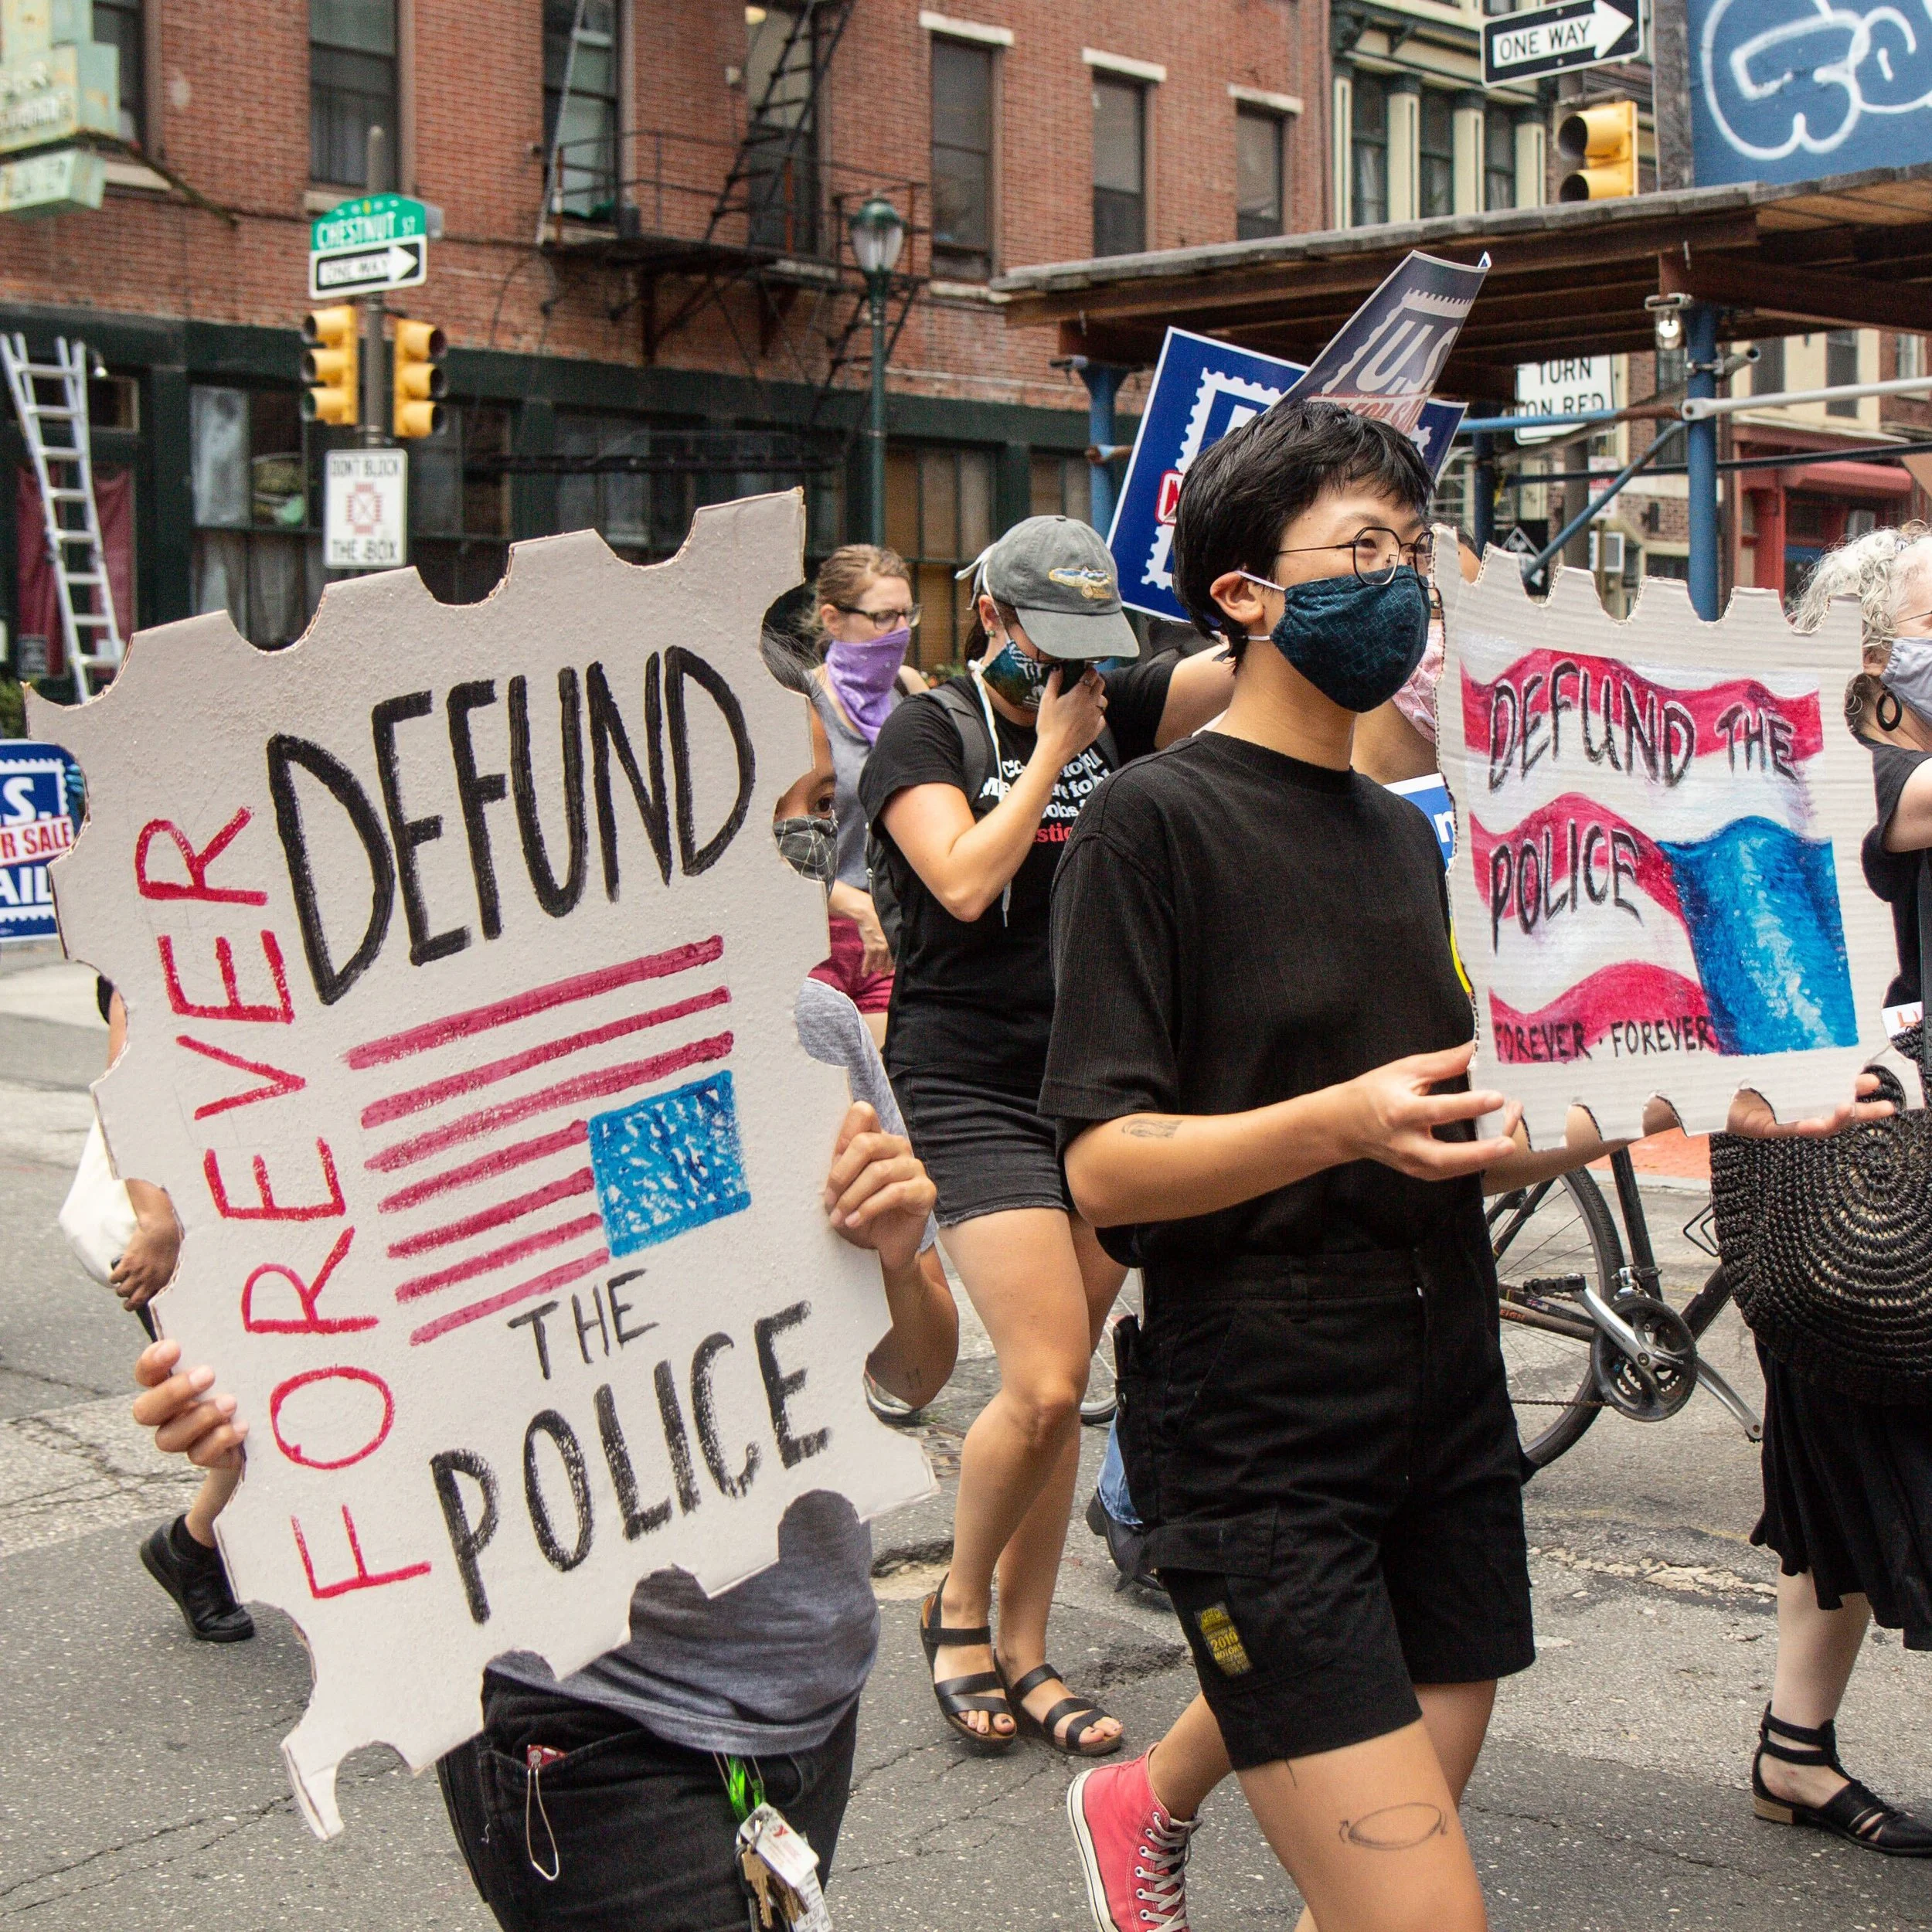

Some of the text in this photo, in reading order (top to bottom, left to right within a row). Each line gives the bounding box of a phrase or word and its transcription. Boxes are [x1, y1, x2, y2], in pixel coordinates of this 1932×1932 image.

[1500, 20, 1590, 60] ONE WAY
[317, 211, 396, 251] CHESTNUT
[326, 258, 389, 284] ONE WAY
[364, 459, 399, 477] BLOCK
[332, 539, 397, 560] THE BOX
[1488, 658, 1799, 794] DEFUND THE
[23, 822, 71, 855] SALE
[267, 645, 756, 1005] DEFUND
[1488, 817, 1645, 956] POLICE
[1495, 1015, 1718, 1063] FOREVER FOREVER
[134, 806, 430, 1600] FOREVER
[506, 1267, 661, 1380] THE
[429, 1299, 835, 1626] POLICE
